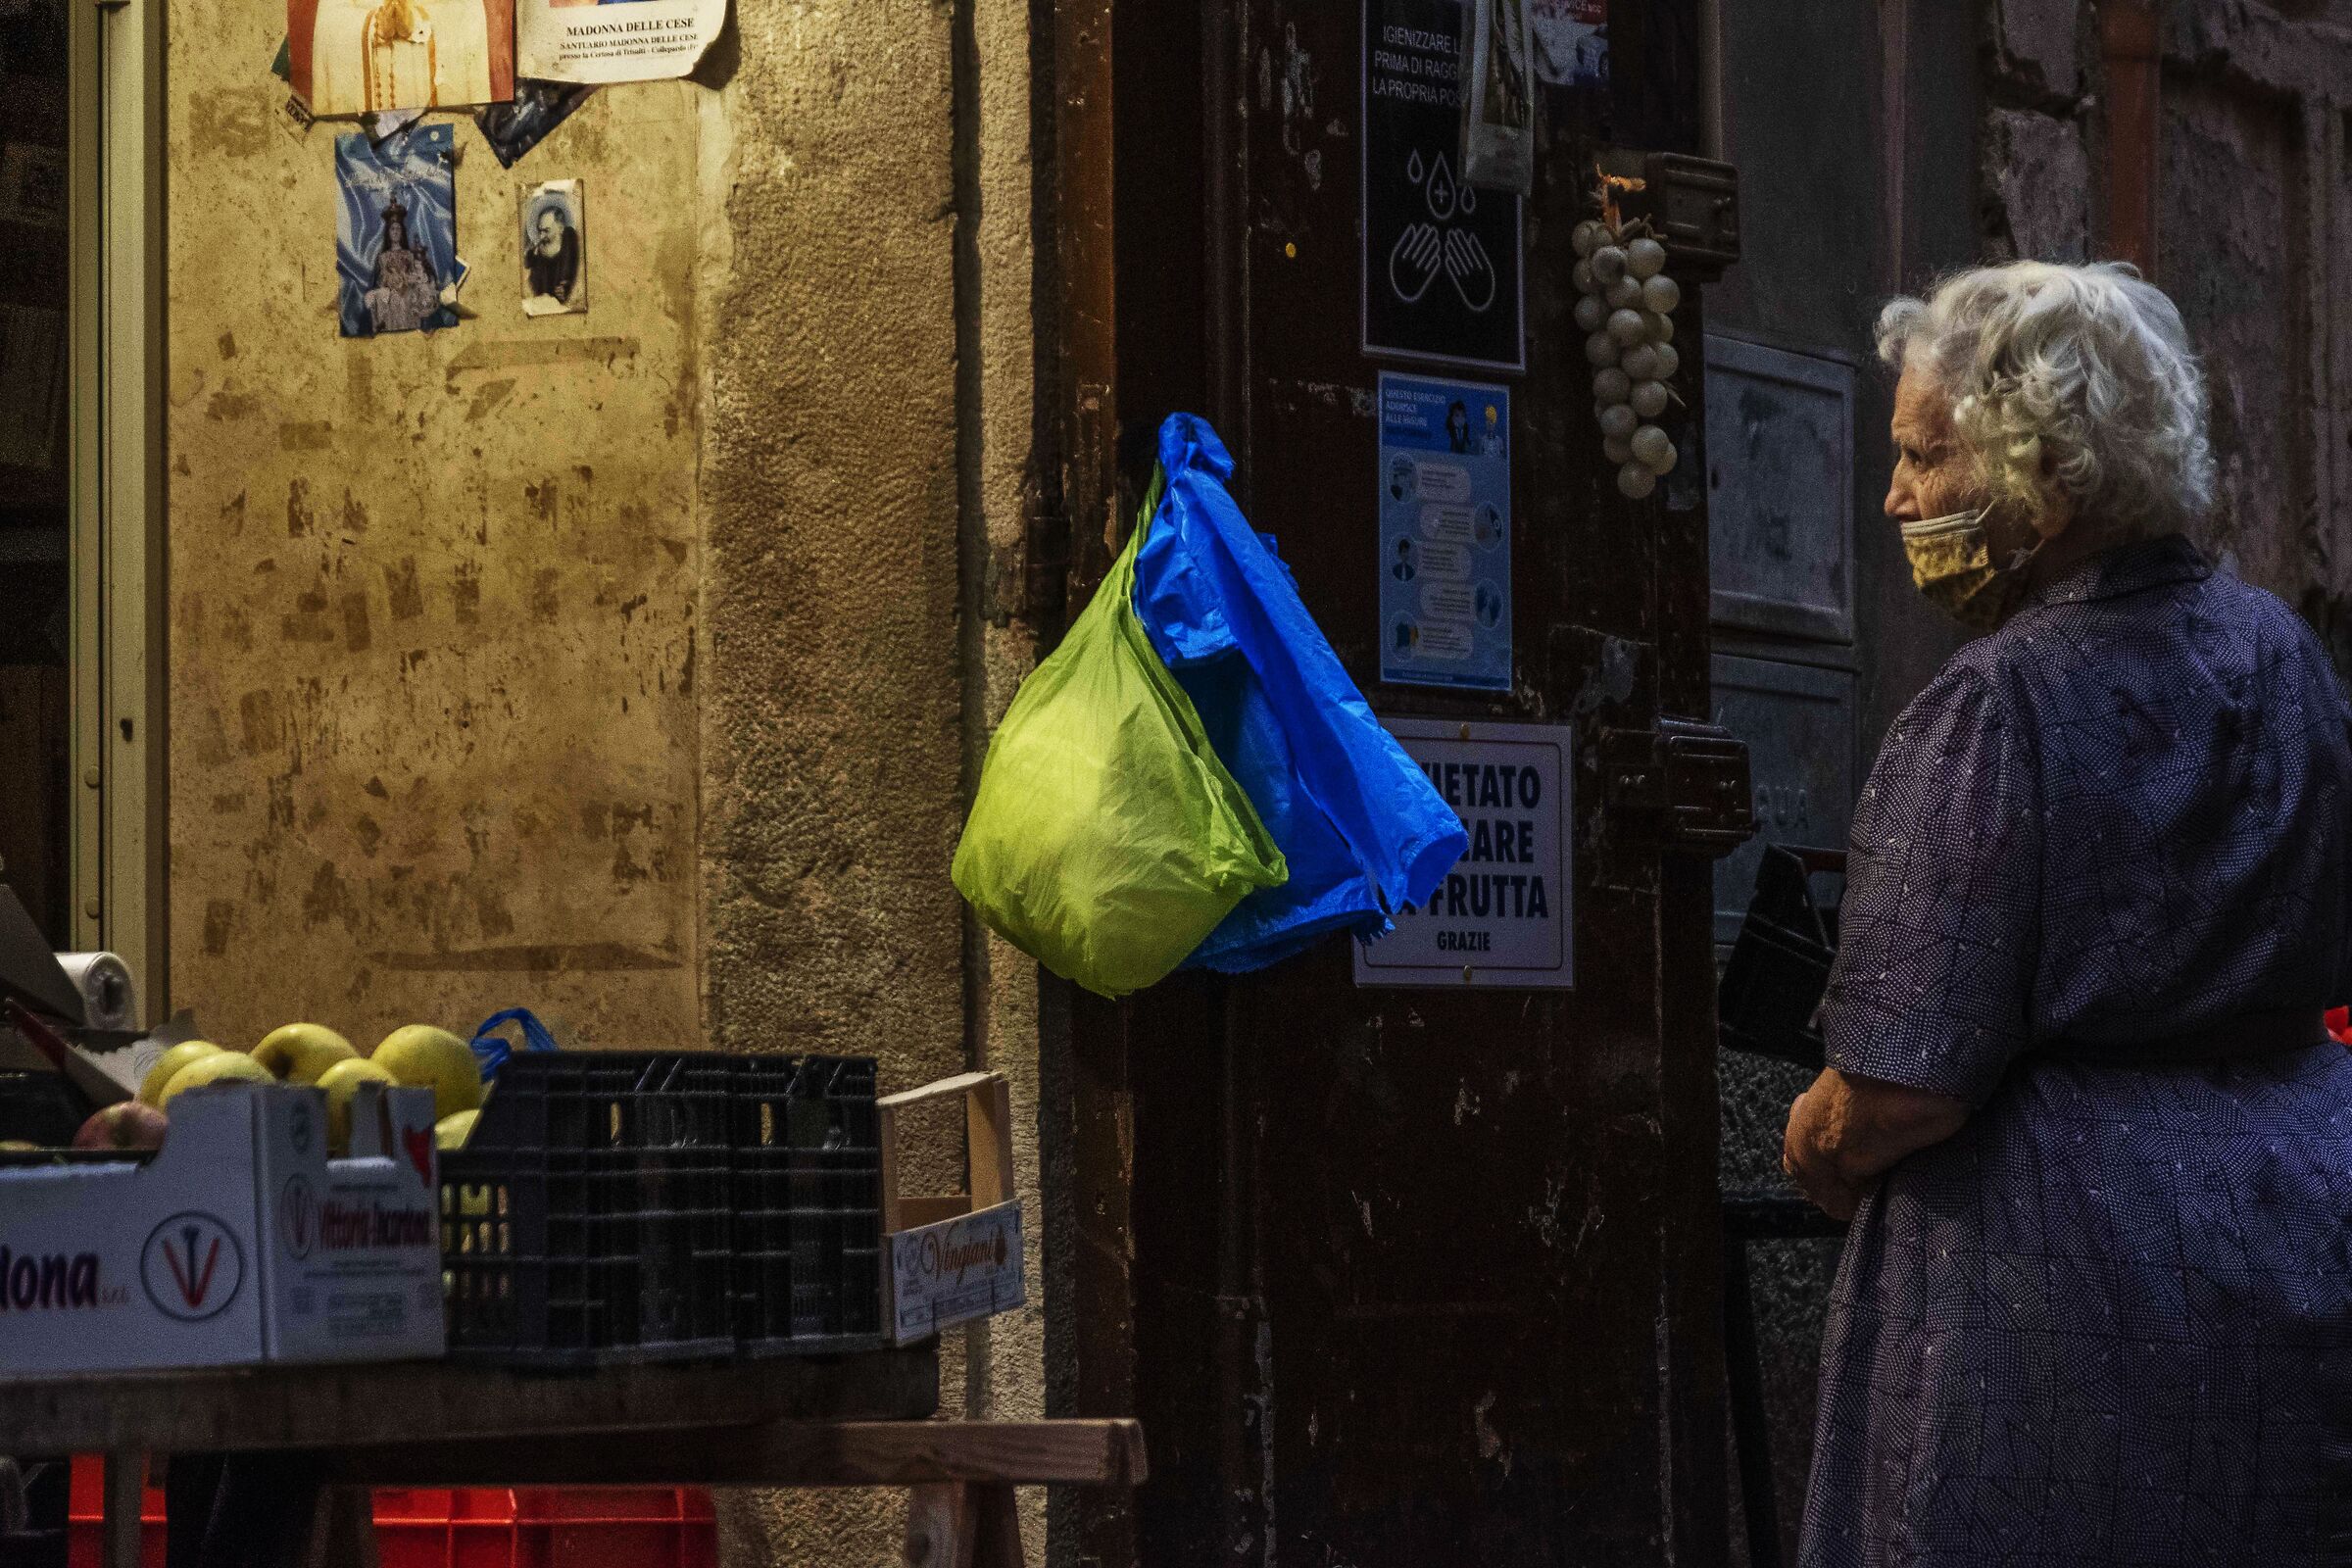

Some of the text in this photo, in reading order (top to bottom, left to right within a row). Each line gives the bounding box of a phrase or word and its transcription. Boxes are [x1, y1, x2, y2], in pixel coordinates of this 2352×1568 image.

[560, 40, 607, 50] SANTUARIO
[610, 36, 649, 47] MADONNA
[651, 34, 676, 43] DELLE
[566, 18, 695, 36] MADONNA DELLE CESE
[1383, 25, 1460, 55] IGIENIZZARE L
[1374, 50, 1457, 80] PRIMA DI RAGG
[1372, 75, 1460, 108] LA PROPRIA POS
[1459, 818, 1534, 862] ARE
[1430, 874, 1548, 918] FRUTTA
[1437, 930, 1491, 952] GRAZIE
